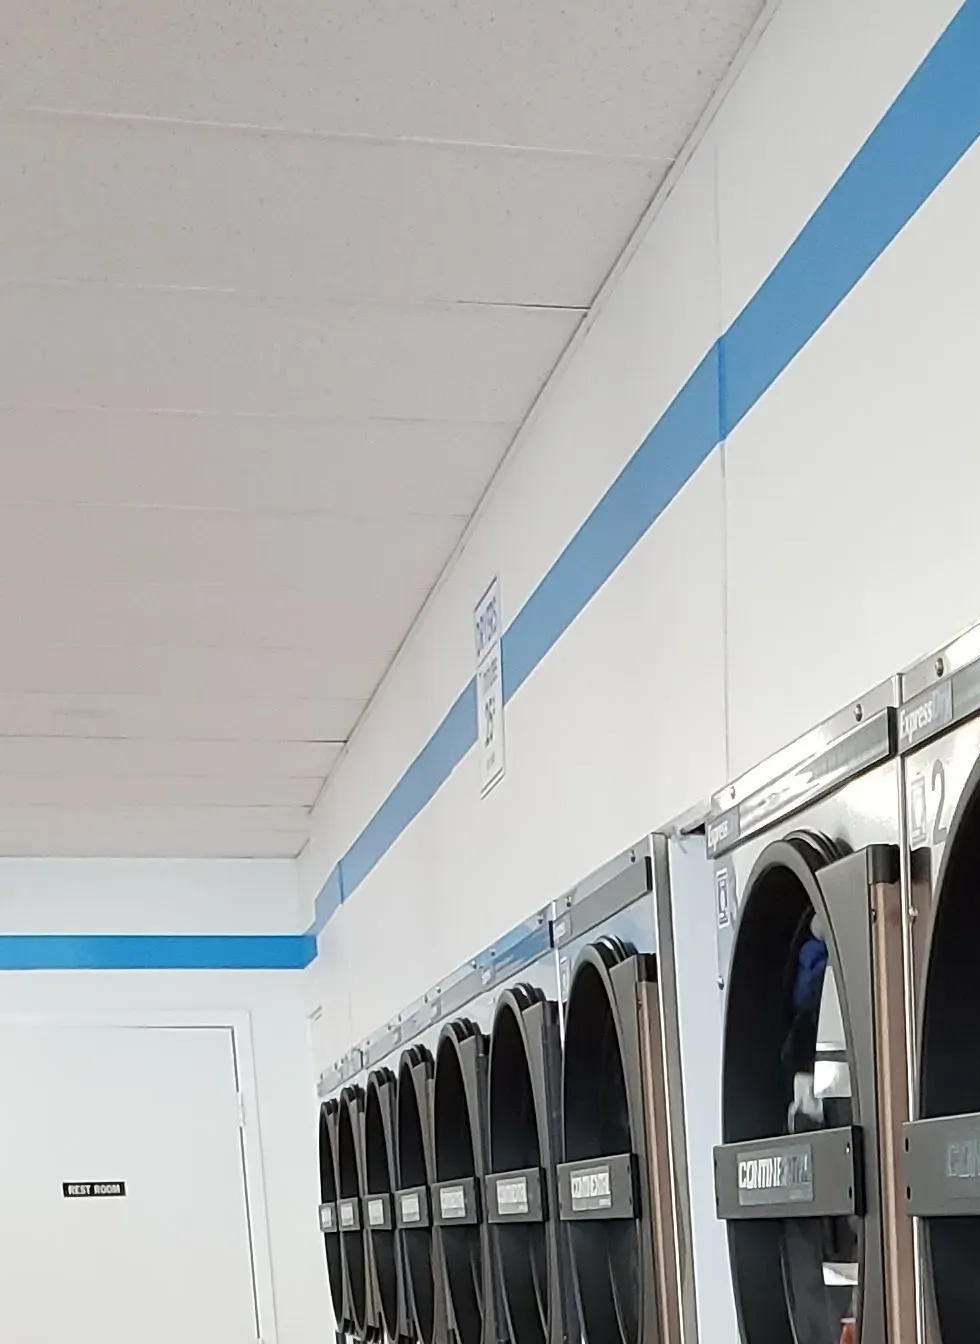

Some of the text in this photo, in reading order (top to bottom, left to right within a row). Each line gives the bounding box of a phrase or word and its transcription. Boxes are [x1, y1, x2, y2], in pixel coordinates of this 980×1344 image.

[932, 758, 947, 845] 2
[68, 1184, 120, 1195] REST ROOM
